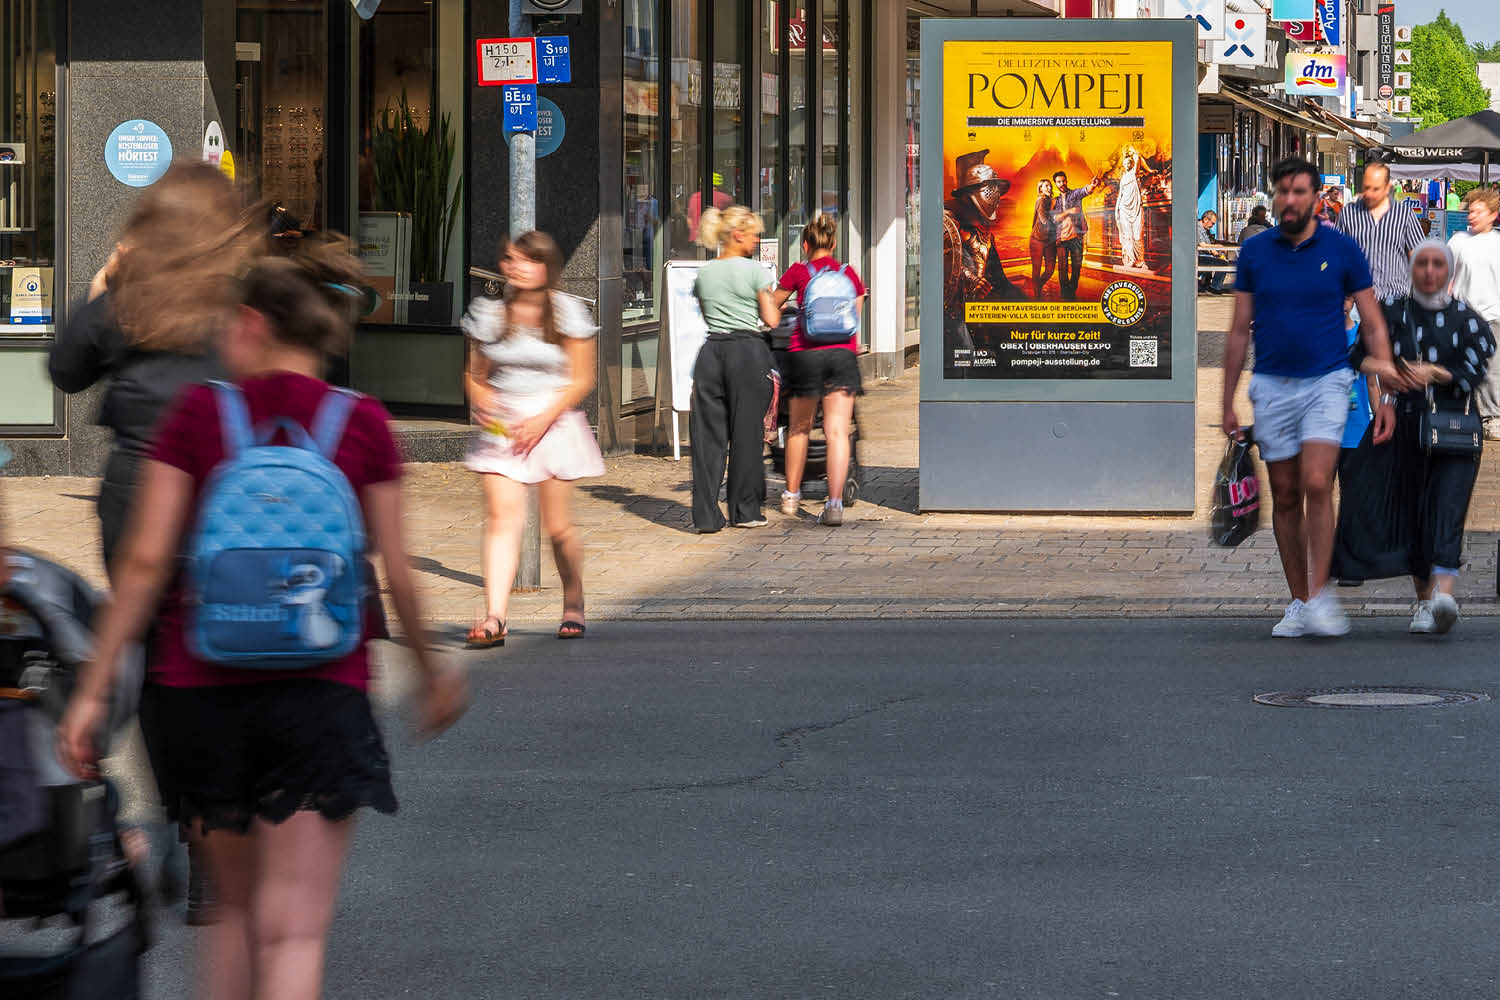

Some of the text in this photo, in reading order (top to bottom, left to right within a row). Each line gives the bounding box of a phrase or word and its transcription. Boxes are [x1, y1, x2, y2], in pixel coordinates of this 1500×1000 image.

[998, 60, 1114, 68] DIE LETZTEN TAGE VON
[1302, 60, 1333, 78] dm
[968, 73, 1145, 114] POMPEJI
[1056, 118, 1111, 126] AUSSTELLUNG
[118, 150, 158, 161] HÖRTEST
[1010, 330, 1101, 340] Nur für kurze Zeit!
[1011, 357, 1101, 367] pompeji-ausstellung.de
